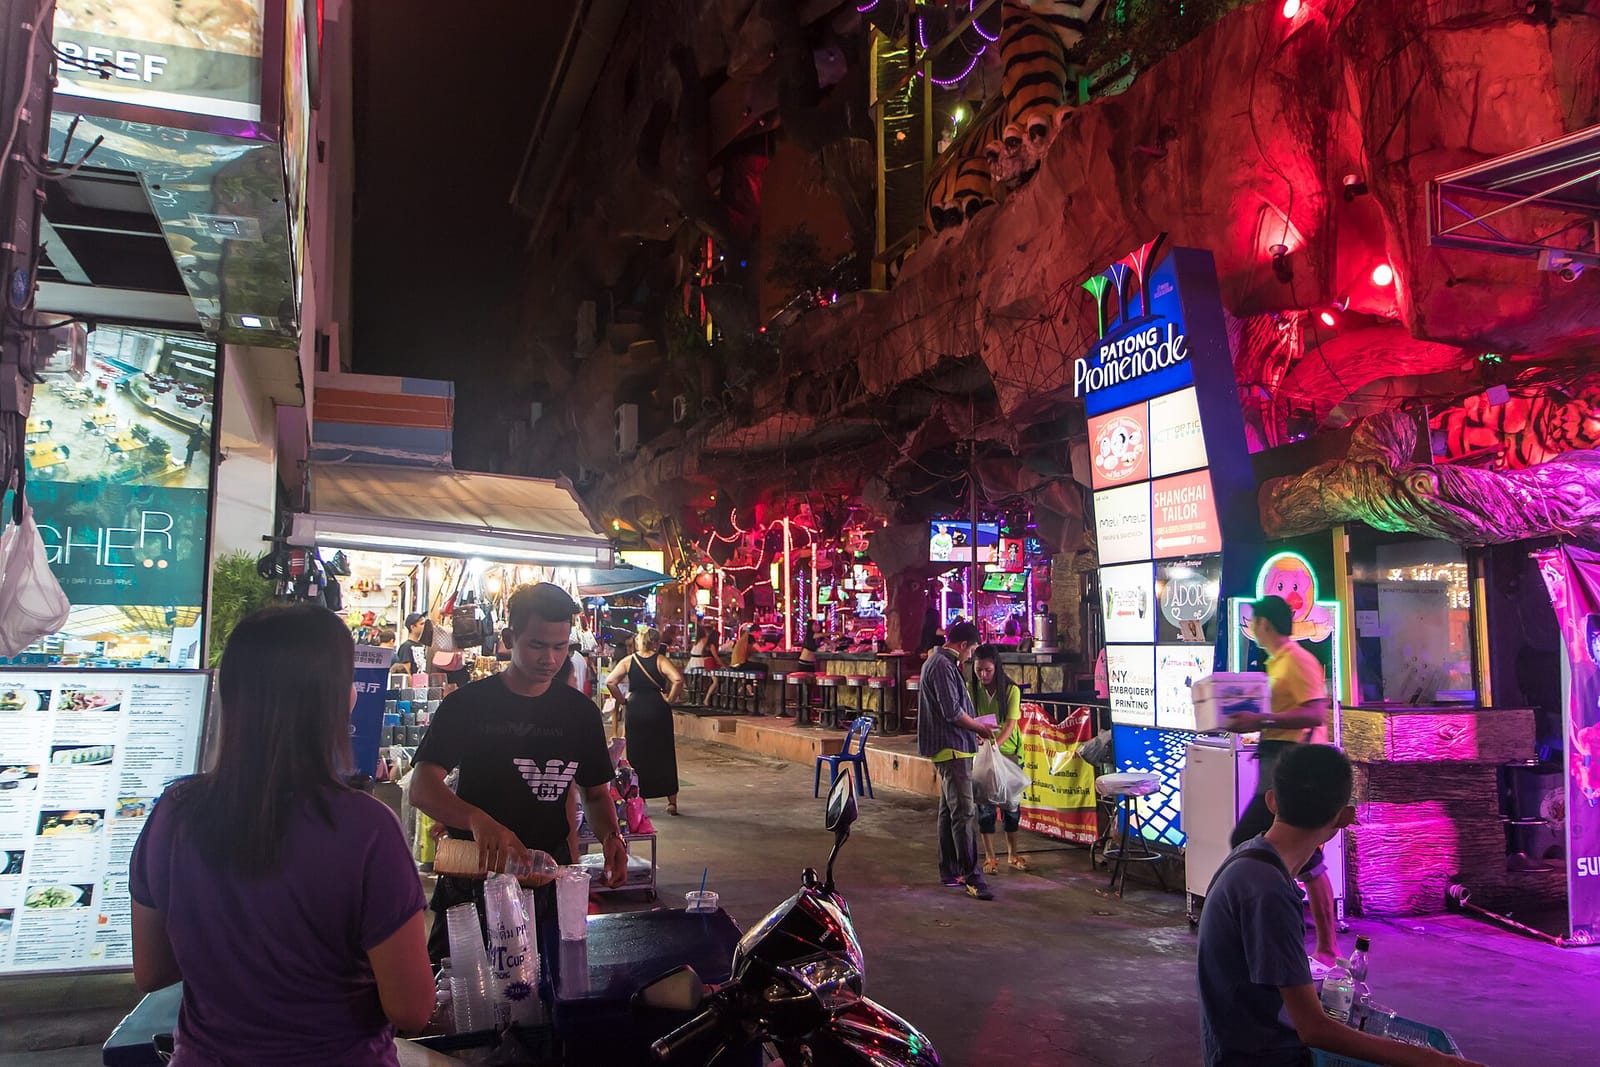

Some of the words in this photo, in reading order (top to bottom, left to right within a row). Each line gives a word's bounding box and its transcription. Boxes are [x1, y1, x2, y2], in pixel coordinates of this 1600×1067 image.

[57, 41, 168, 82] BEEF
[1100, 327, 1157, 363] PATONG
[1074, 323, 1188, 398] Promenade
[1153, 484, 1207, 508] SHANGHAI
[1162, 502, 1198, 523] TAILOR
[1110, 685, 1154, 697] EMBROIDERY
[1115, 698, 1149, 710] PRINTING
